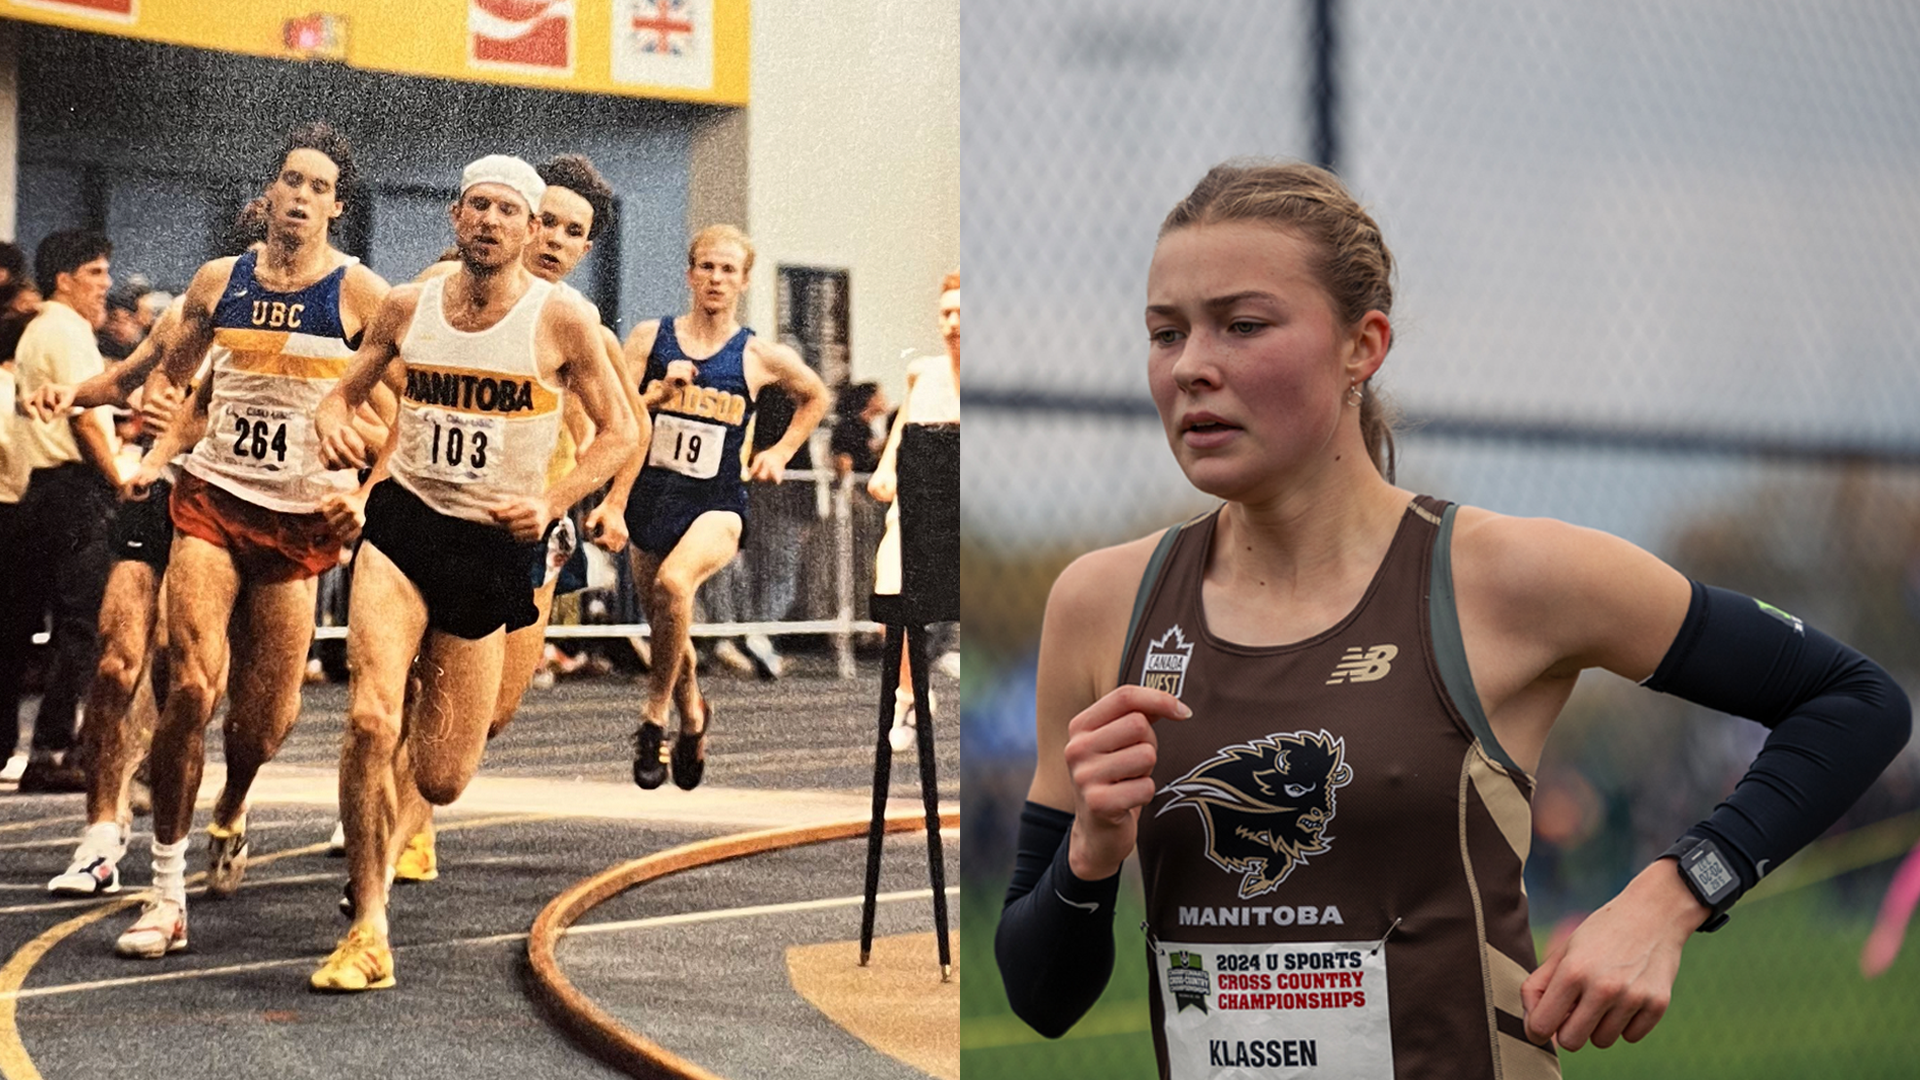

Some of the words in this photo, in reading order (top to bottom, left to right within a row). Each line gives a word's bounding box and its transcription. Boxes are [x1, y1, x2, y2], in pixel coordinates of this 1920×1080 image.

[252, 300, 306, 328] UBC
[404, 368, 534, 412] MANITOBA
[233, 417, 287, 462] 264
[432, 424, 488, 469] 103
[673, 431, 702, 463] 19
[1148, 655, 1184, 670] CANADA
[1145, 673, 1180, 695] WEST
[1178, 905, 1345, 926] MANITOBA
[1216, 954, 1261, 972] 2024
[1266, 953, 1279, 971] U
[1284, 951, 1363, 971] SPORTS
[1217, 973, 1272, 991] CROSS
[1277, 971, 1365, 990] COUNTRY
[1217, 991, 1366, 1010] CHAMPIONSHIPS
[1209, 1039, 1318, 1068] KLASSEN
